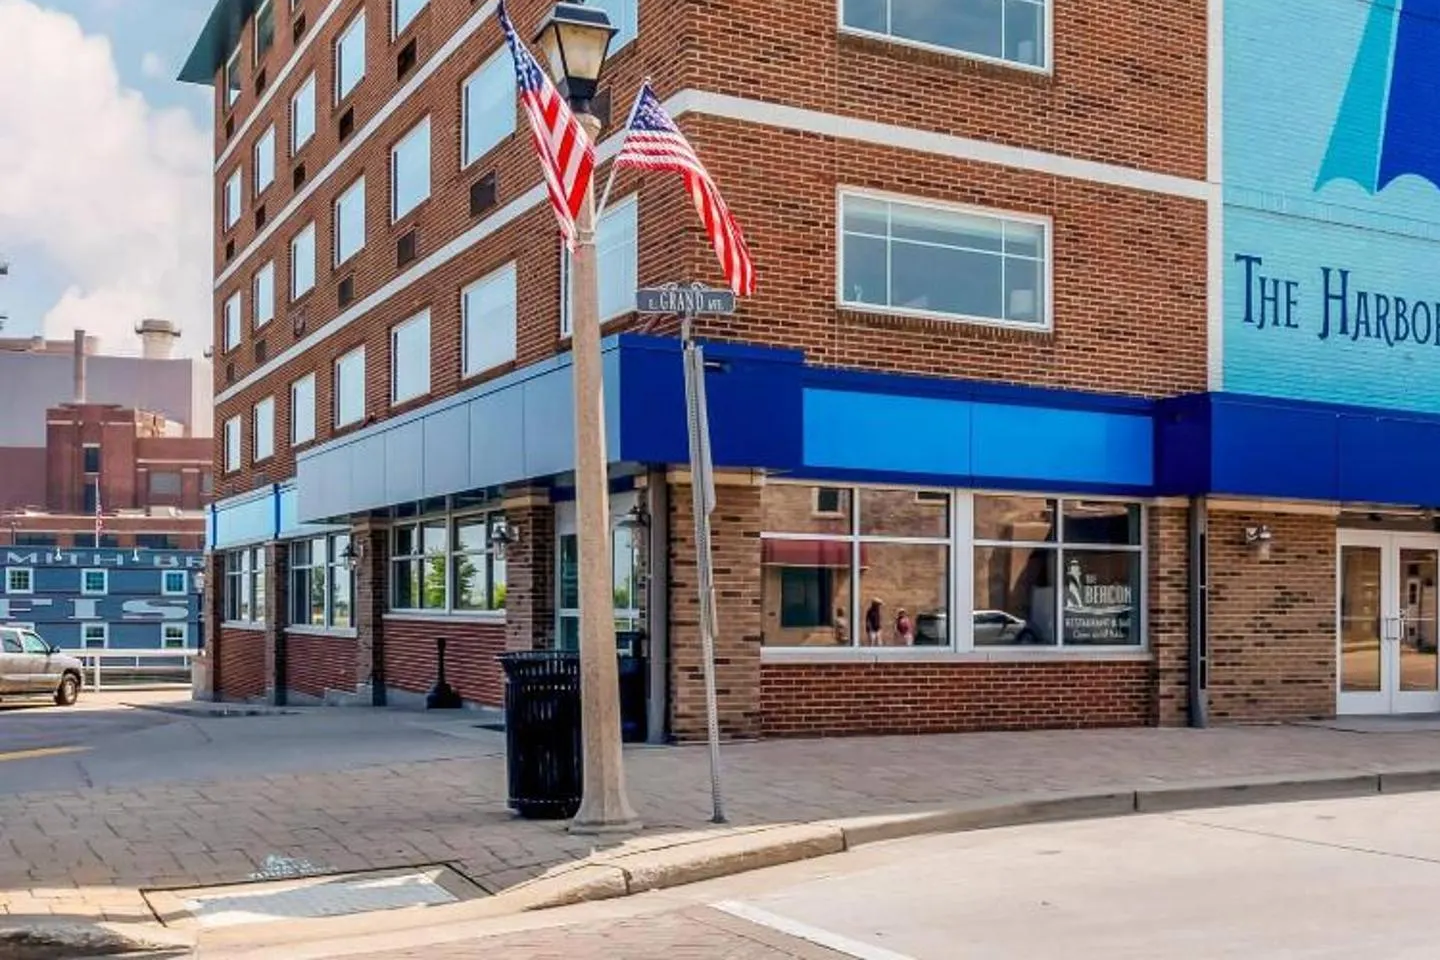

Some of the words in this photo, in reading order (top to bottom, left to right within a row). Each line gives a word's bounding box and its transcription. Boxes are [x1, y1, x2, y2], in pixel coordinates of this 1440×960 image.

[660, 291, 704, 311] GRAND
[1234, 253, 1299, 330] THE
[7, 551, 124, 566] MITH
[1084, 584, 1132, 604] BEACON
[0, 598, 205, 620] FIS
